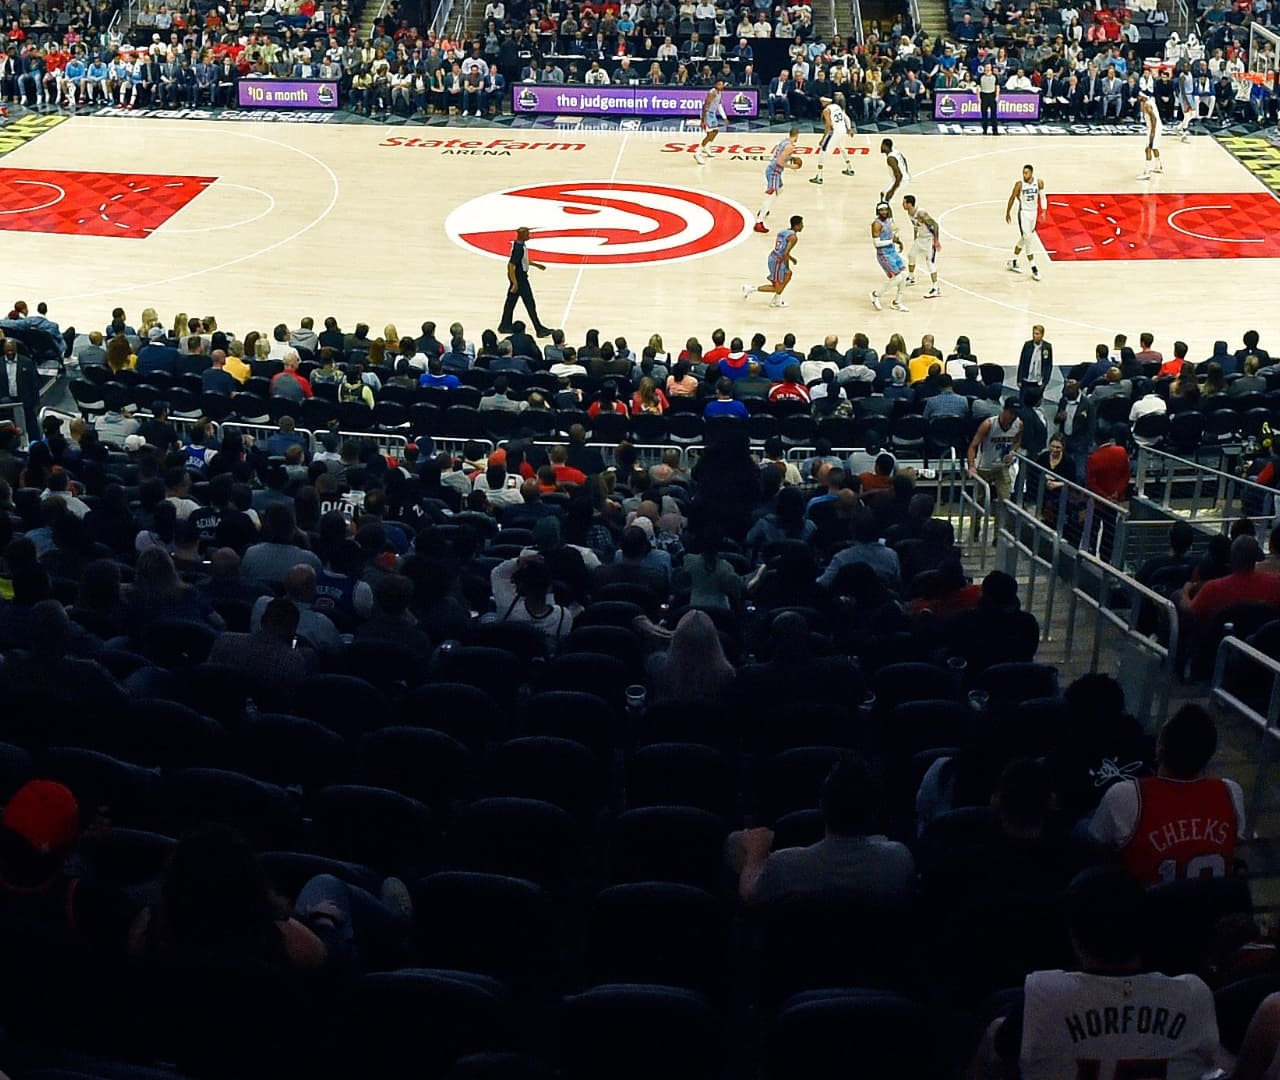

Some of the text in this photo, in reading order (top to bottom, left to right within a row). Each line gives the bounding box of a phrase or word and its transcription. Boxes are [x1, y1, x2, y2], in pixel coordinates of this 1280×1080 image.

[248, 86, 308, 101] $10 a month
[557, 94, 703, 112] the judgement free zon
[999, 100, 1035, 113] fitness
[378, 136, 586, 152] State Farm
[660, 142, 766, 156] State
[441, 150, 511, 158] ARENA
[1149, 819, 1231, 853] CHEEKS
[1066, 1005, 1187, 1044] HORFORD
